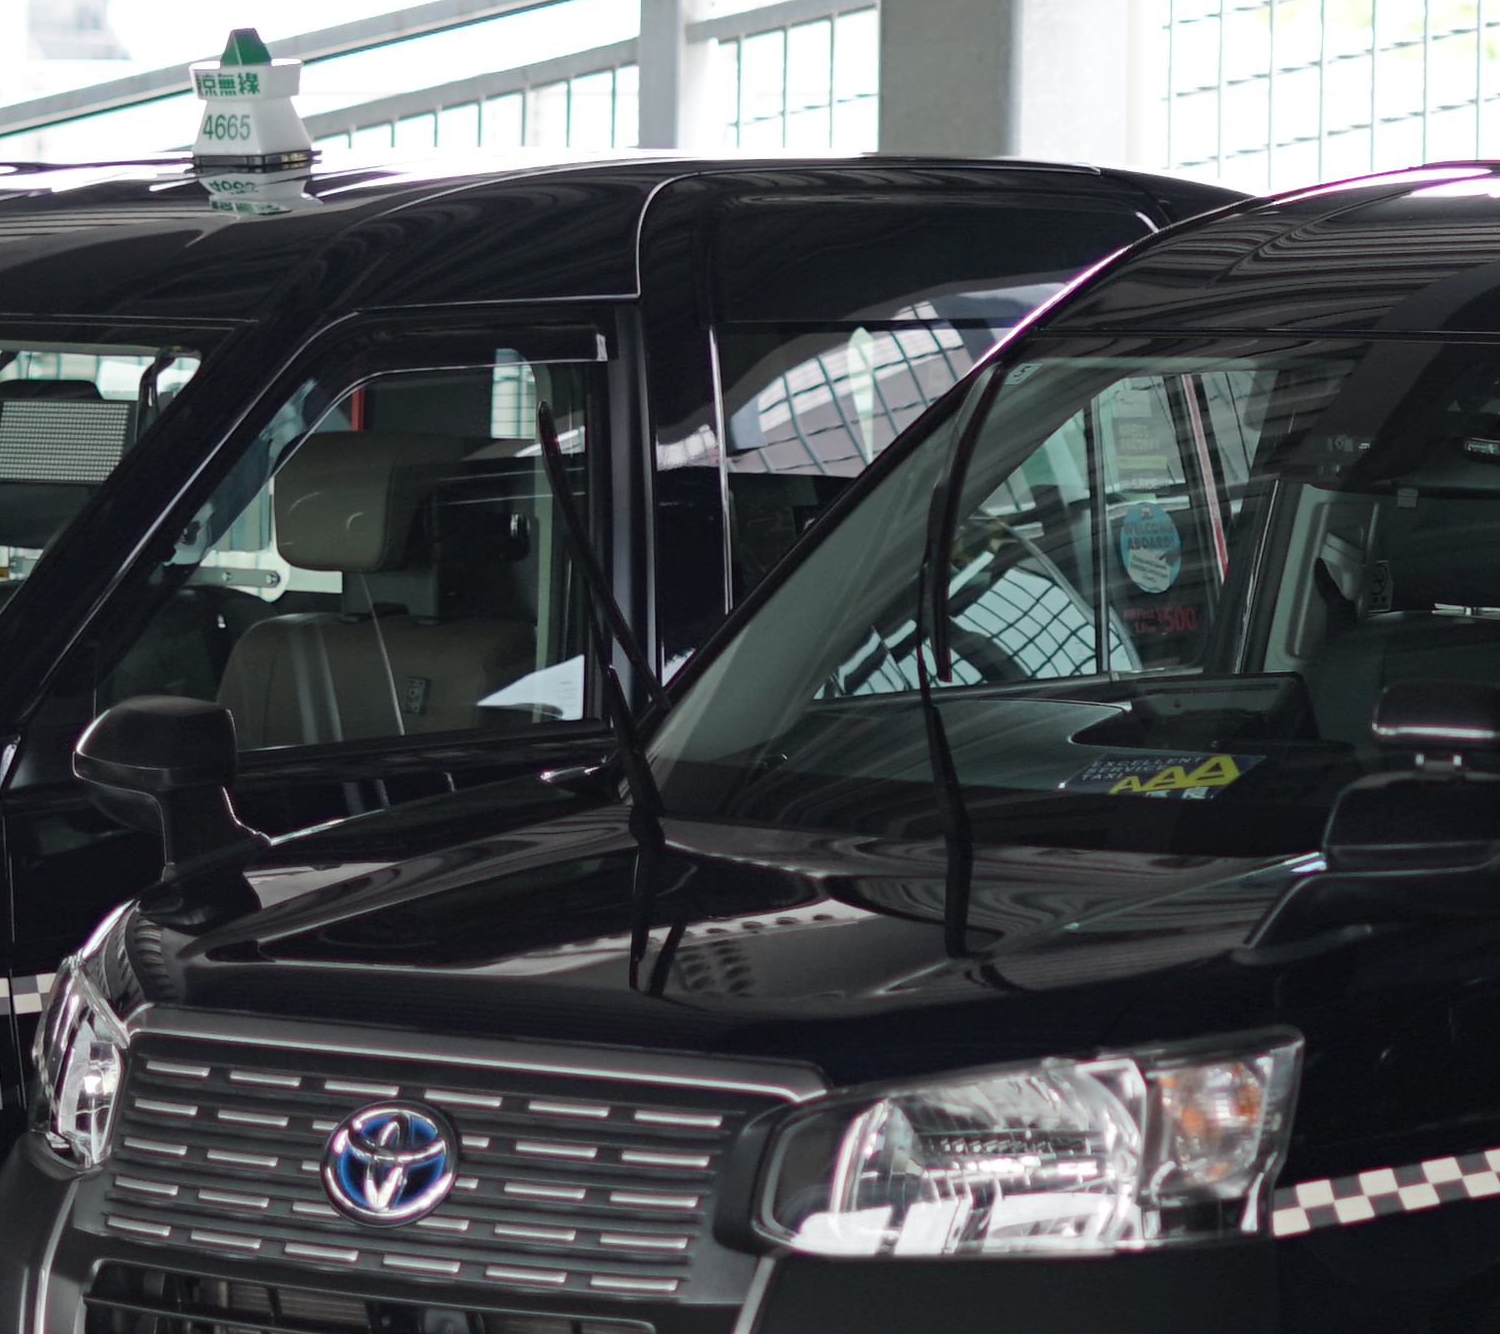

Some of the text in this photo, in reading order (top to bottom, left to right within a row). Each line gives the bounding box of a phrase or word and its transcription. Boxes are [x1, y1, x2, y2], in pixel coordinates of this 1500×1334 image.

[196, 72, 260, 97] 京無線
[203, 114, 251, 141] 4665
